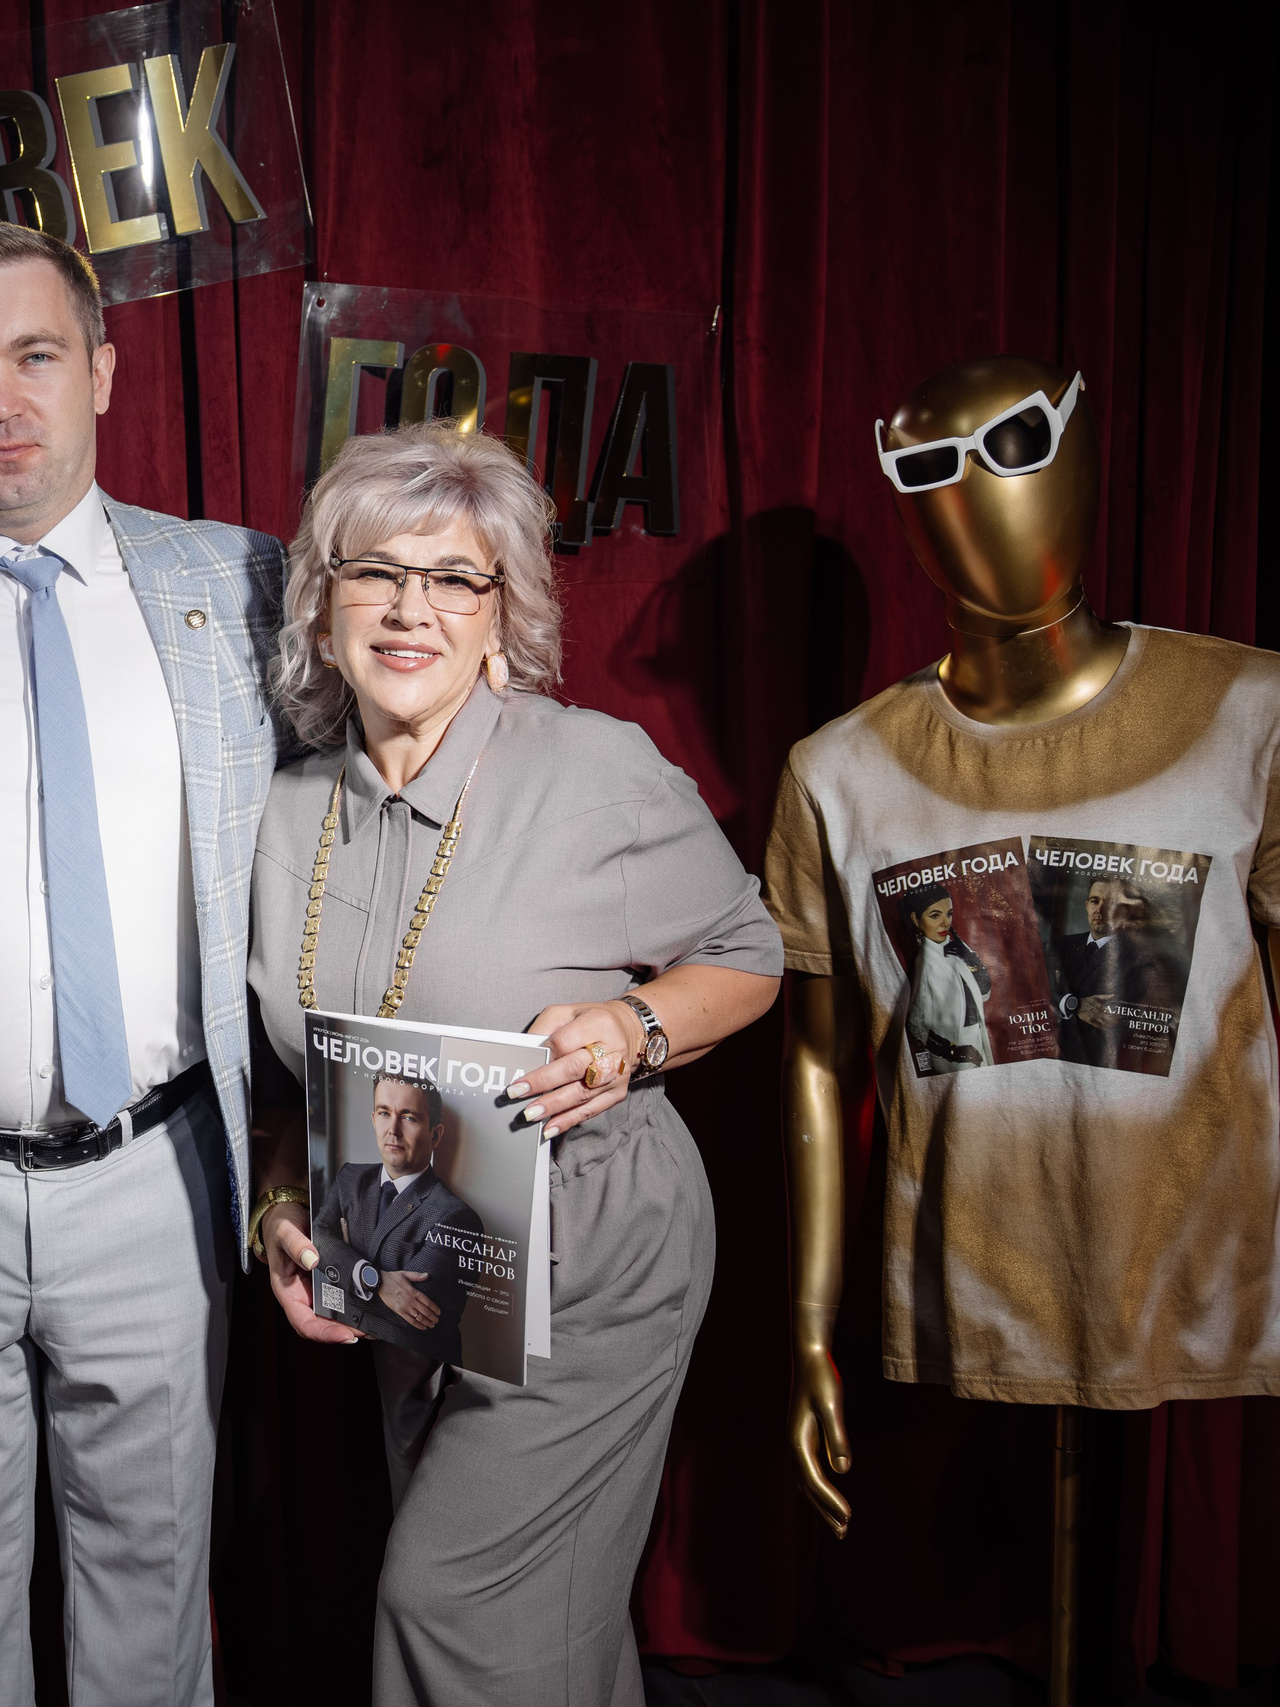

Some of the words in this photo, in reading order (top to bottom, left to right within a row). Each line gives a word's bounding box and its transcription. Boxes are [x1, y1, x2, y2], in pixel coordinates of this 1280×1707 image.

[877, 862, 957, 897] ЧЕЛОВЕК
[961, 851, 1019, 876] ГОДА
[1035, 849, 1135, 874] ЧЕЛОВЕК
[1140, 860, 1198, 884] ГОДА
[1009, 1010, 1048, 1025] ЮЛИЯ
[1103, 1005, 1172, 1022] АЛЕКСАНДР
[1019, 1022, 1051, 1035] ТЮС
[1129, 1019, 1170, 1034] ВЕТРОВ
[312, 1033, 439, 1082] ЧЕЛОВЕК
[364, 1072, 406, 1086] НОВОГО
[412, 1082, 465, 1096] ФОРМАТА
[424, 1230, 517, 1262] АЛЕКСАНДР
[458, 1255, 515, 1280] ВЕТРОВ
[457, 1278, 491, 1292] Инвестиции
[466, 1291, 485, 1300] забота
[483, 1304, 509, 1315] будущем
